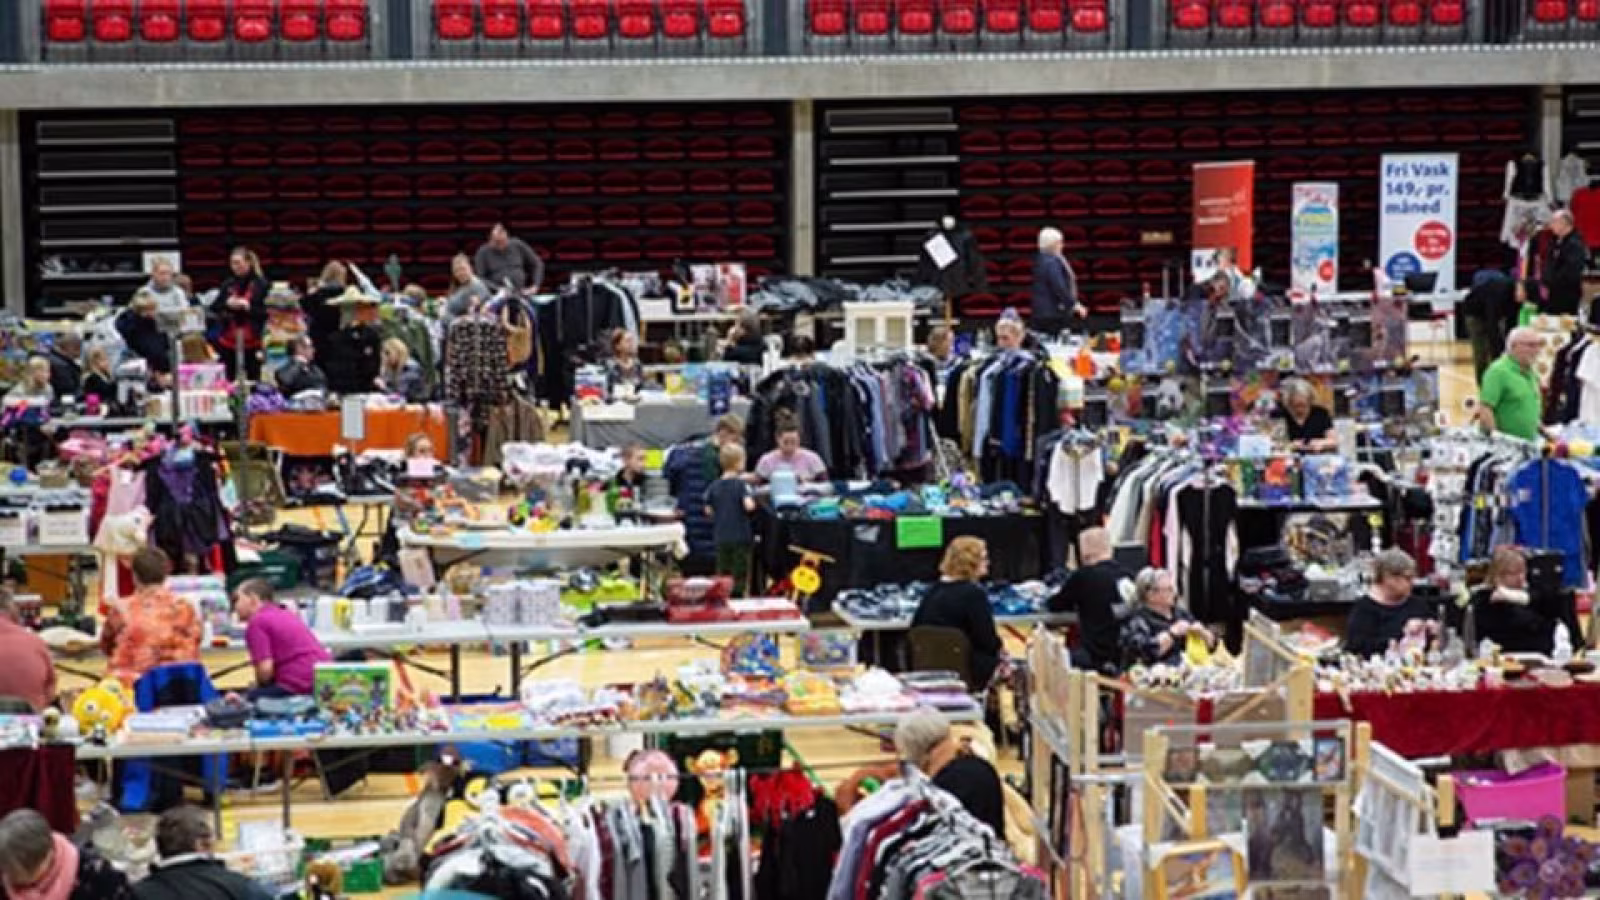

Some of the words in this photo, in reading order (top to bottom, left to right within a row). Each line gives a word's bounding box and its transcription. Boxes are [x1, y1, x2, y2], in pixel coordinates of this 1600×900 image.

[1386, 162, 1408, 176] Fri
[1411, 161, 1449, 176] Vask
[1385, 198, 1441, 214] måned
